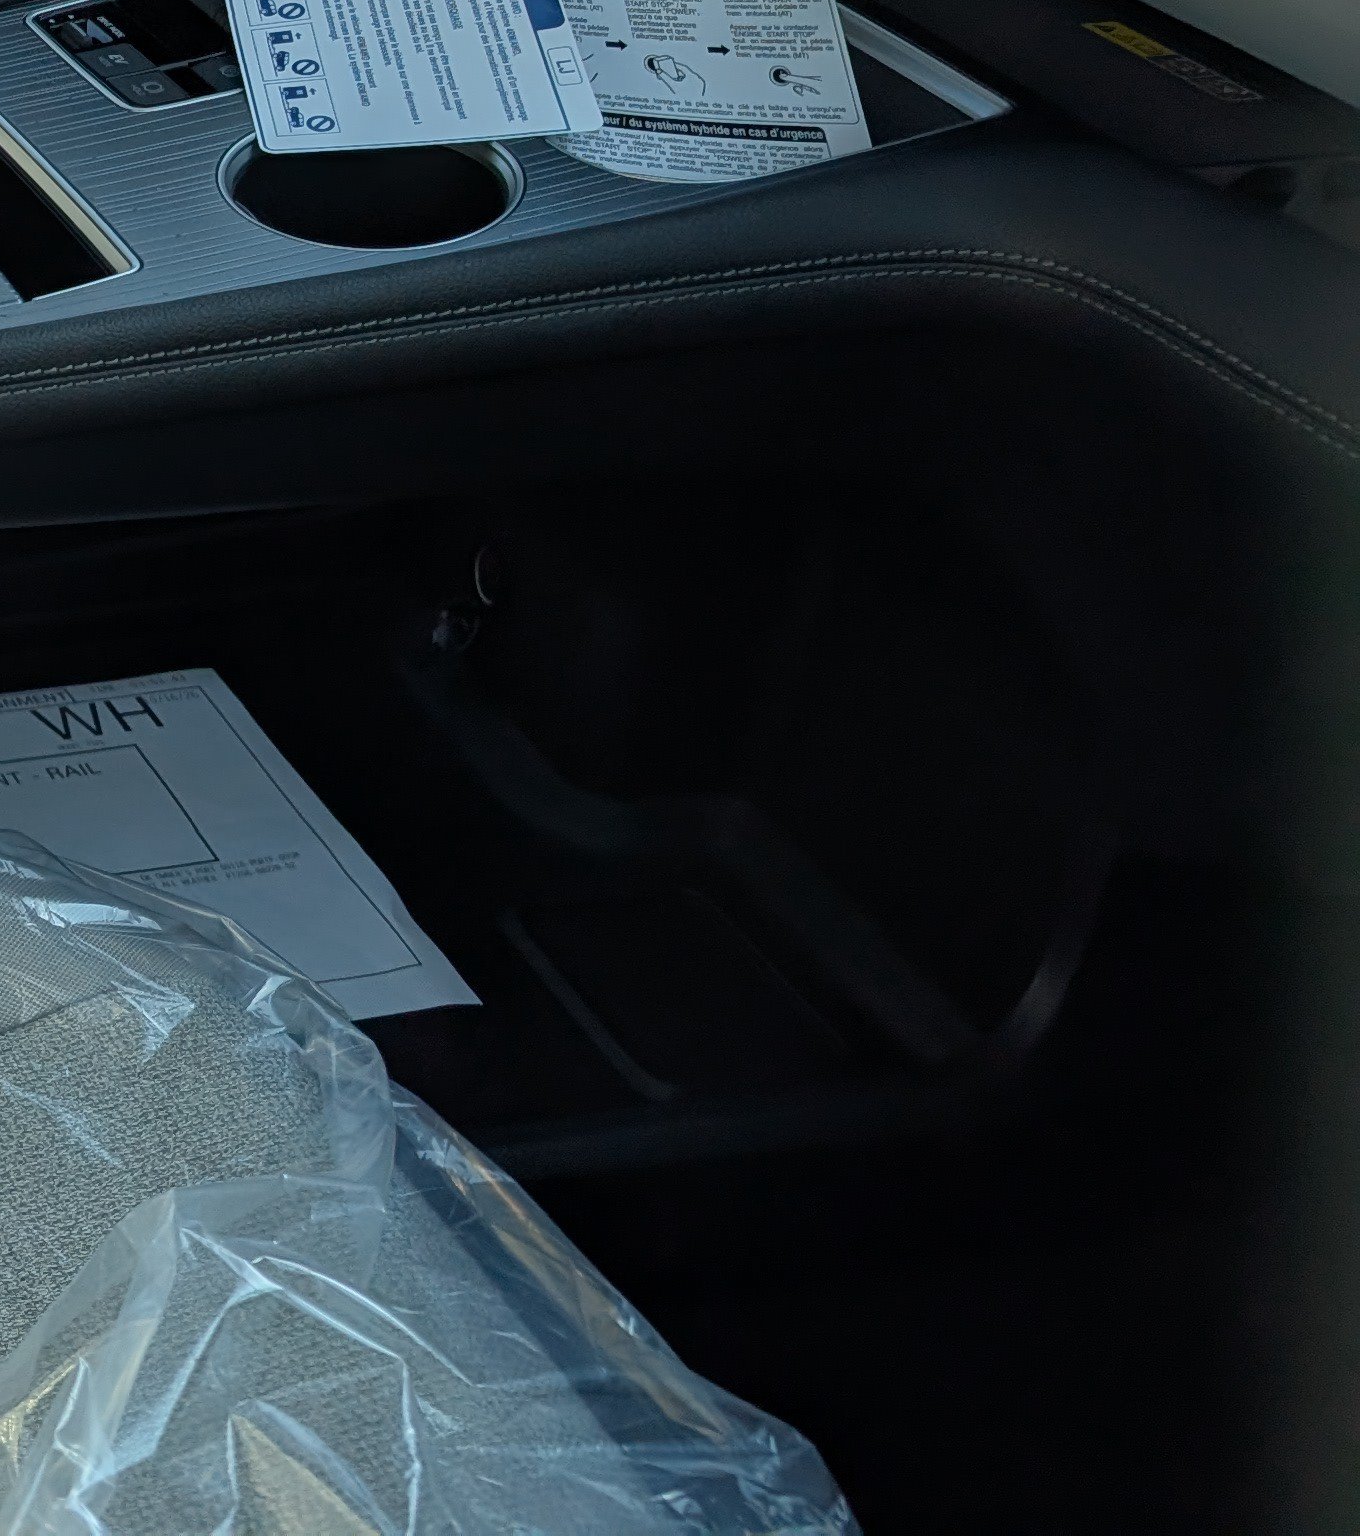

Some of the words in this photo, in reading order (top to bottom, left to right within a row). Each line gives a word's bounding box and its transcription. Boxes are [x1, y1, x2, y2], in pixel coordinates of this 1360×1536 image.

[555, 59, 575, 73] LJ
[645, 120, 689, 132] système
[691, 123, 730, 136] hybride
[748, 128, 767, 138] cas
[770, 128, 823, 141] d'urgence
[30, 696, 164, 740] WH
[45, 763, 101, 783] RAIL
